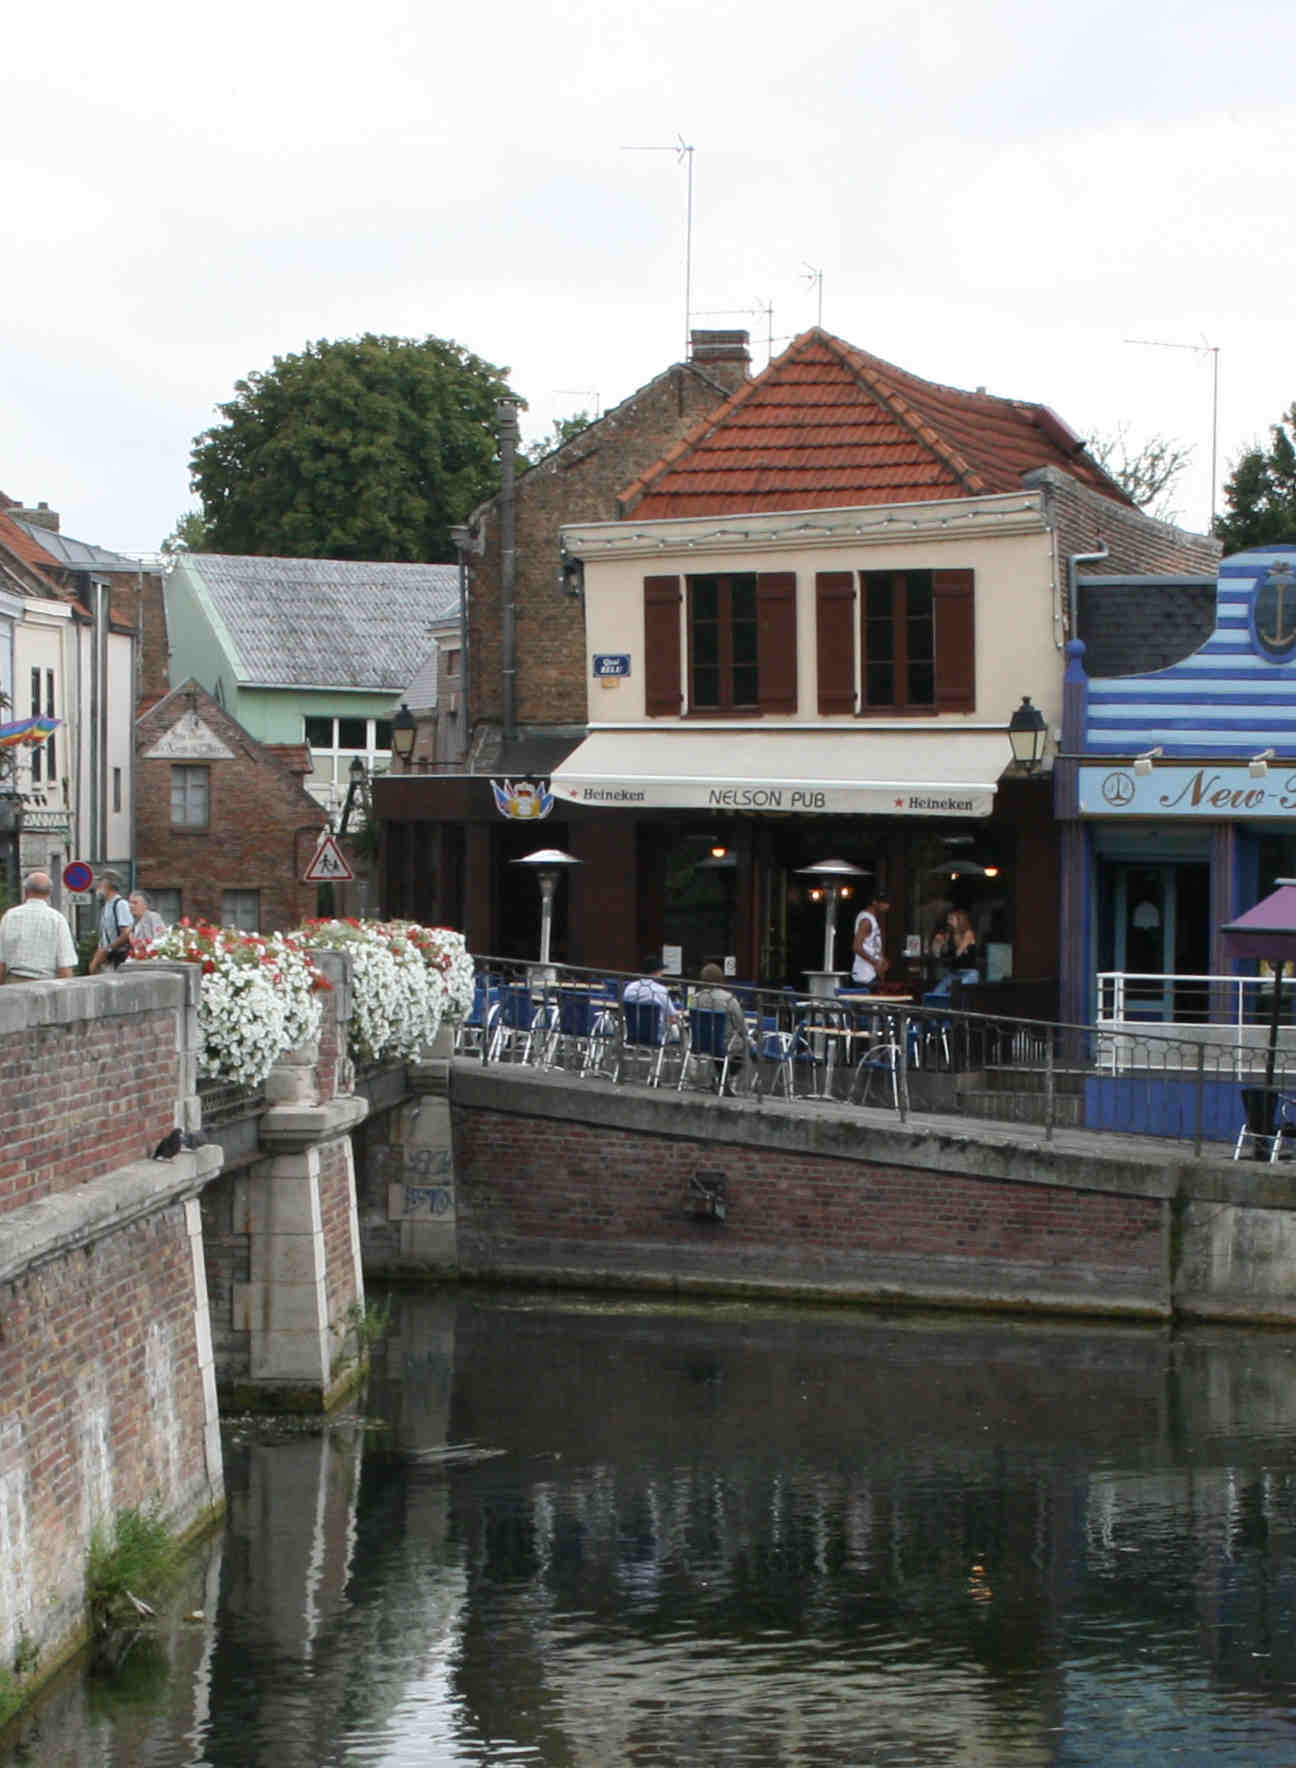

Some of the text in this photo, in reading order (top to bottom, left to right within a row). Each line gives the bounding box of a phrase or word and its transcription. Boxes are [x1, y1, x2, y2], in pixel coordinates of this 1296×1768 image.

[583, 788, 645, 802] Heineken
[708, 789, 827, 808] NELSON PUB
[908, 796, 974, 811] Heineken
